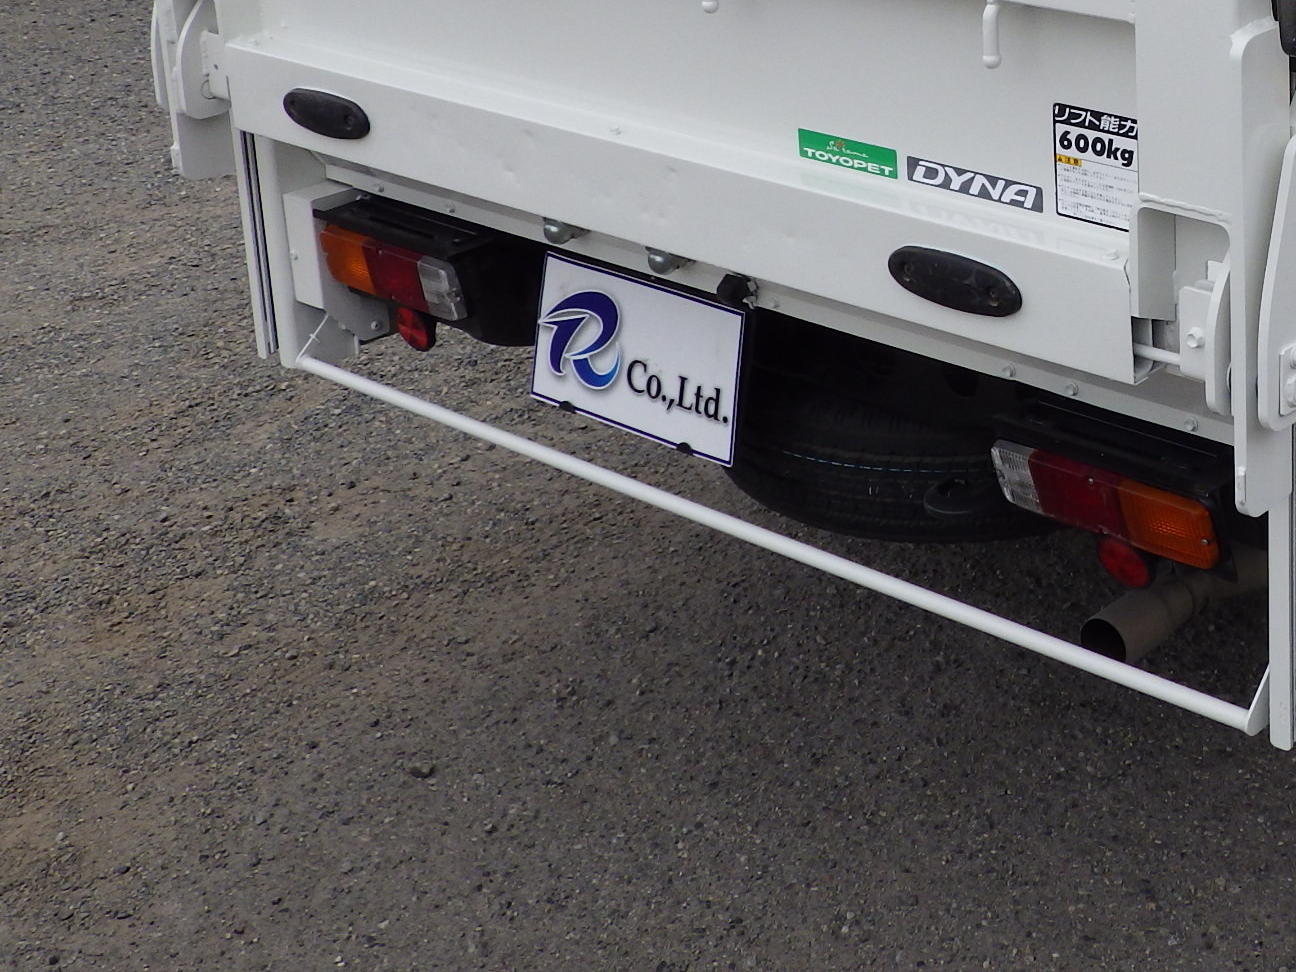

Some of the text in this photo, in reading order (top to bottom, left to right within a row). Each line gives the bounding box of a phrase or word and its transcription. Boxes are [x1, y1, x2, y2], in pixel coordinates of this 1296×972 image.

[1053, 105, 1138, 136] リフト能力
[802, 147, 894, 176] TOYOPET
[1058, 130, 1135, 168] 600kg
[911, 161, 1040, 209] DYNA
[626, 359, 730, 424] Co.,Ltd.
